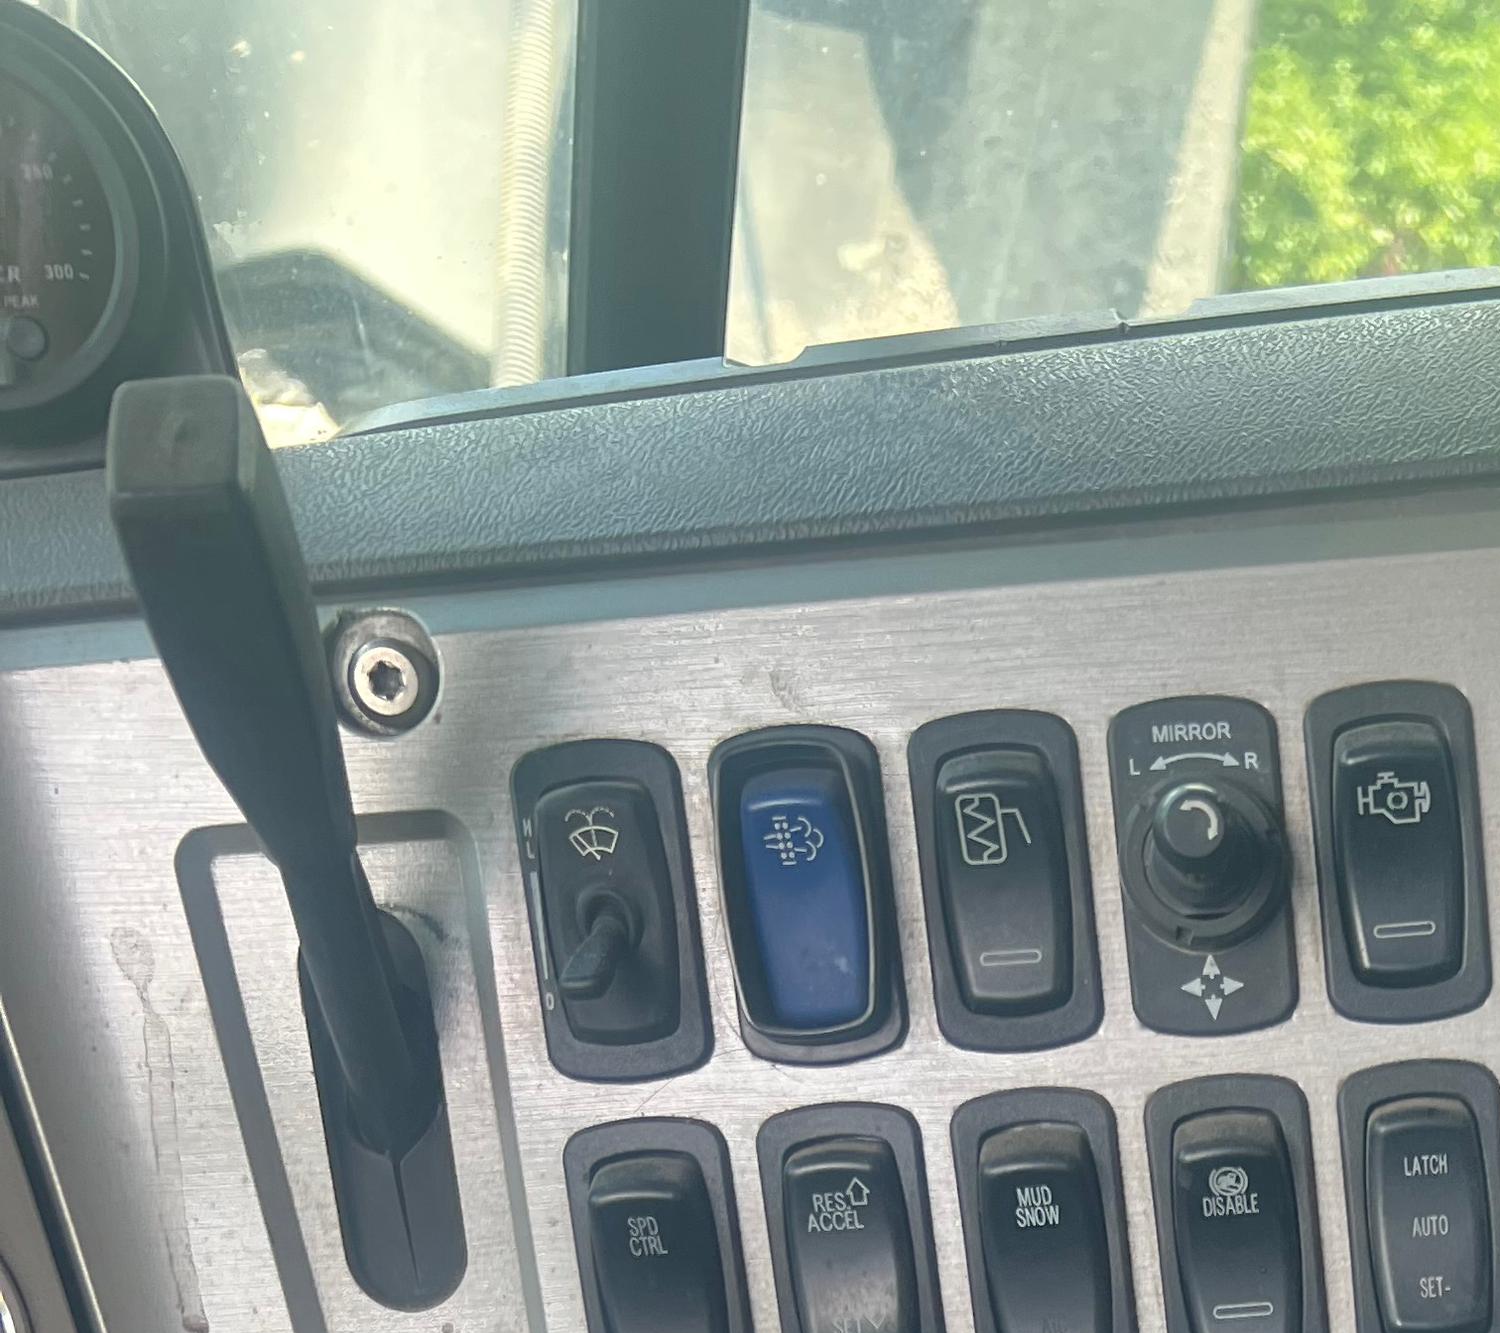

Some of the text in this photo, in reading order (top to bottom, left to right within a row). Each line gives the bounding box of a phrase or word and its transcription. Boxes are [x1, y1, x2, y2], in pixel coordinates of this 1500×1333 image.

[1151, 720, 1232, 743] MIRROR
[1128, 757, 1141, 776] L
[1243, 751, 1259, 770] R
[1403, 1152, 1449, 1177] LATCH
[1015, 1184, 1053, 1208] MUD
[1202, 1192, 1260, 1217] DISABLE
[627, 1216, 659, 1237] SPD
[807, 1210, 865, 1233] ACCEL
[1014, 1204, 1060, 1228] SNOW
[1412, 1213, 1450, 1238] AUTO
[629, 1235, 669, 1257] CTRL
